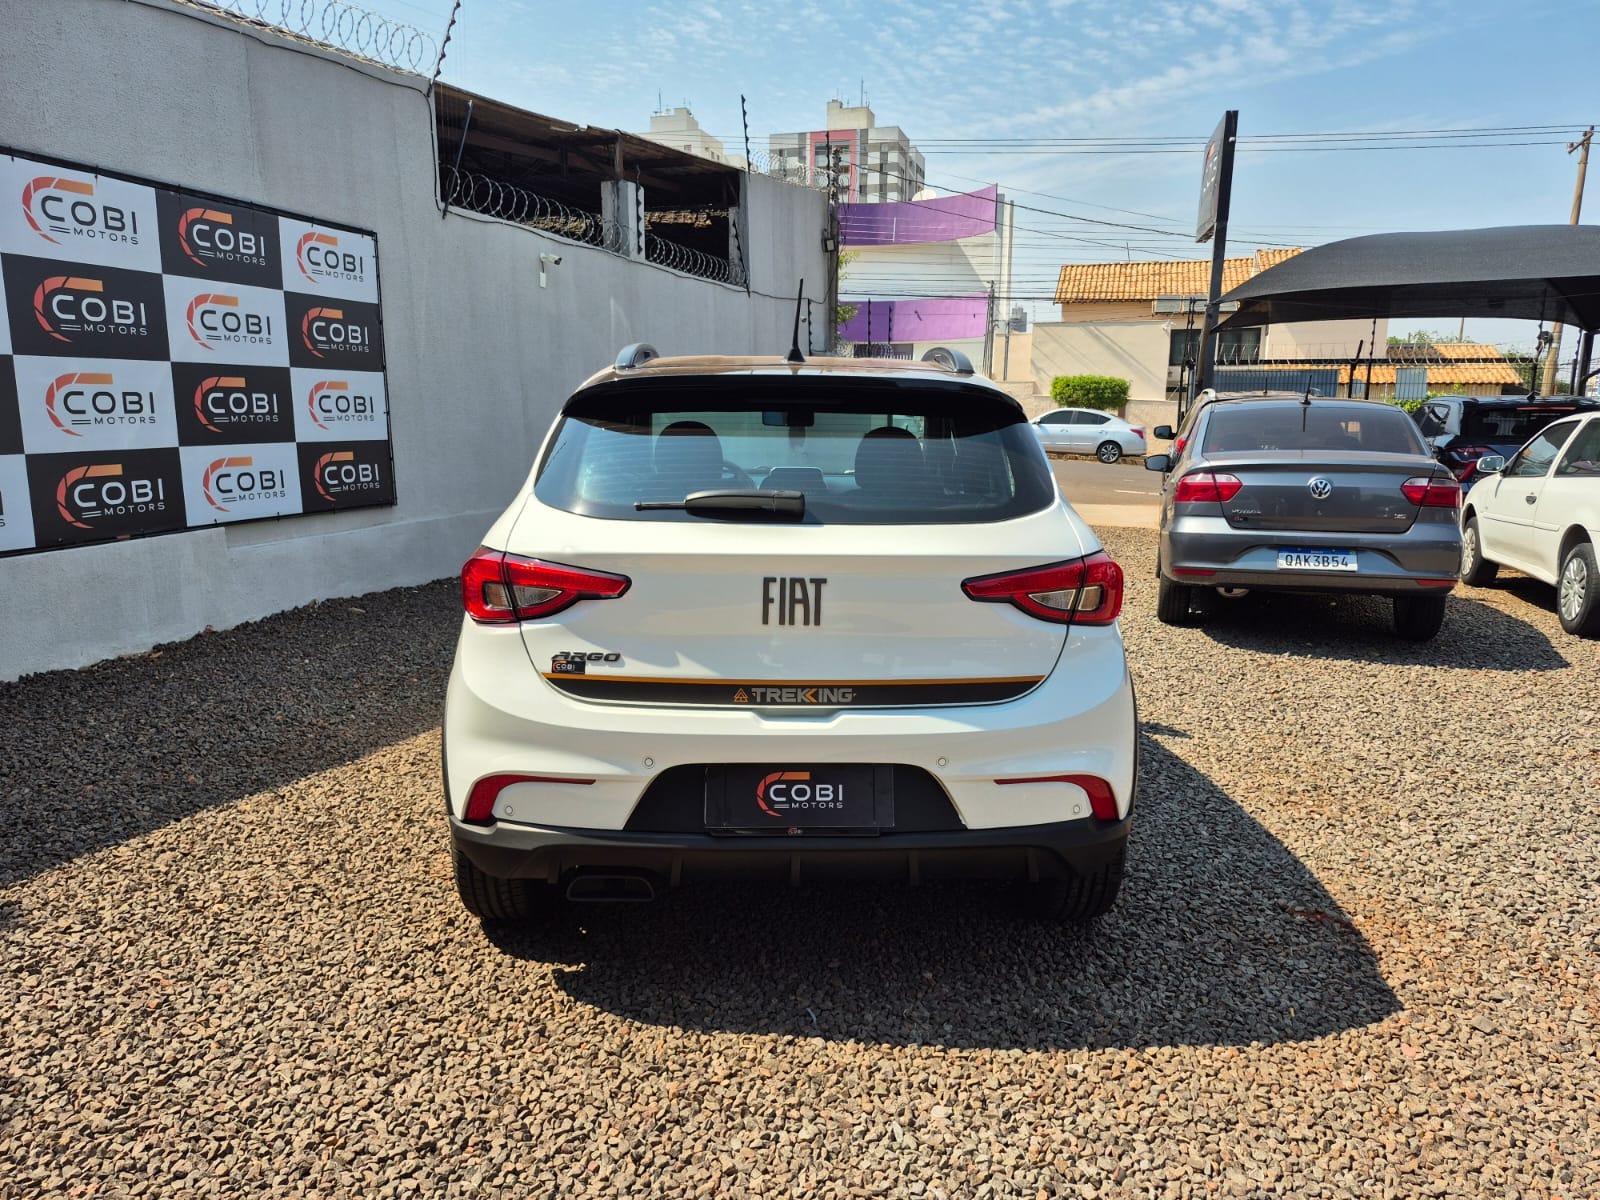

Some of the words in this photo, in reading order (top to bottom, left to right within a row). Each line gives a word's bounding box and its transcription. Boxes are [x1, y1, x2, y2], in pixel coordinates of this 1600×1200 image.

[41, 195, 138, 235] COBI
[73, 228, 139, 245] MOTORS
[193, 225, 265, 257] COBI
[216, 251, 266, 266] MOTORS
[307, 245, 364, 273] COBI
[325, 269, 364, 283] MOTORS
[52, 294, 147, 326] COBI
[84, 323, 148, 336] MOTORS
[200, 310, 271, 337] COBI
[223, 334, 272, 345] MOTORS
[312, 321, 369, 345] COBI
[331, 343, 370, 353] MOTORS
[63, 391, 155, 415] COBI
[207, 392, 278, 414] COBI
[318, 395, 374, 414] COBI
[95, 416, 156, 425] MOTORS
[231, 414, 279, 423] MOTORS
[337, 414, 375, 422] MOTORS
[216, 469, 285, 494] COBI
[324, 463, 380, 485] COBI
[73, 478, 164, 508] COBI
[238, 490, 286, 501] MOTORS
[343, 482, 380, 492] MOTORS
[104, 502, 166, 515] MOTORS
[1285, 554, 1348, 568] QAK3B54
[762, 577, 827, 626] FIAT
[769, 784, 843, 801] COBI
